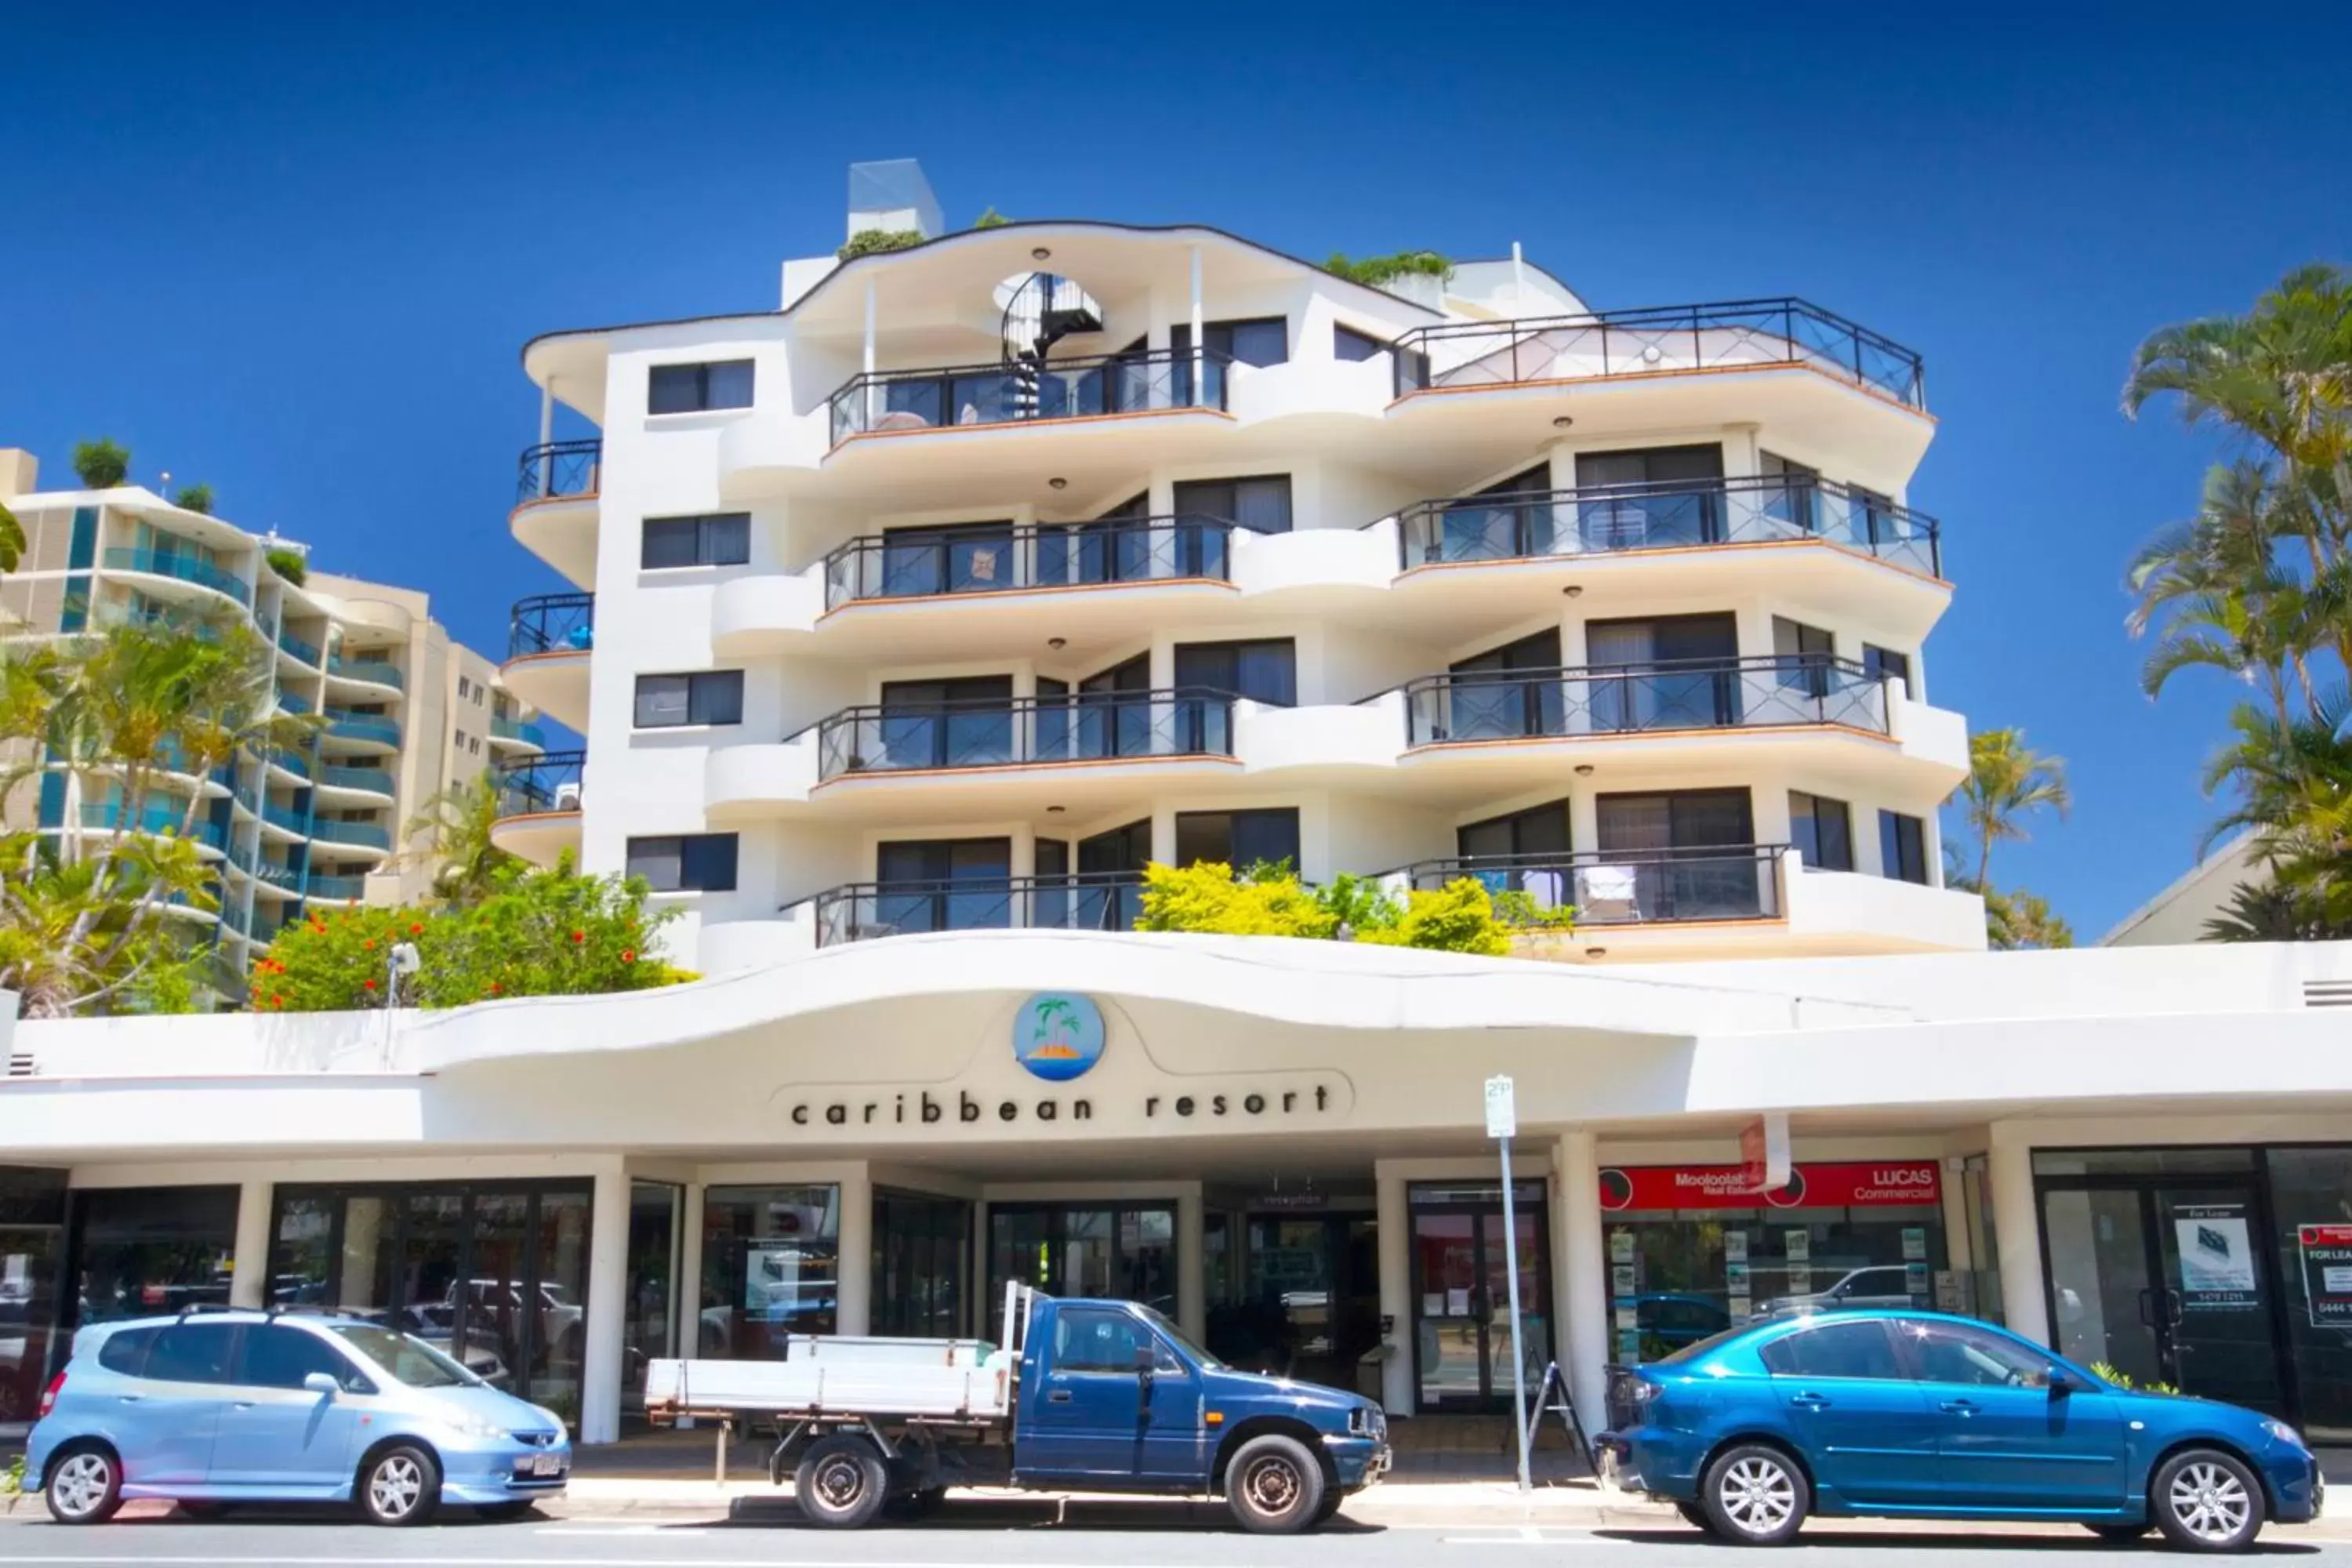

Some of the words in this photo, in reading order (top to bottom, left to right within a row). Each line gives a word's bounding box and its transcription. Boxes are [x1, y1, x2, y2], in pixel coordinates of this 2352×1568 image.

[791, 1091, 1091, 1124] caribbean
[1146, 1085, 1327, 1117] resort
[1873, 1169, 1933, 1185] LUCAS
[1854, 1187, 1935, 1200] Commercial
[2309, 1250, 2331, 1259] FOR
[2332, 1250, 2352, 1259] LEA
